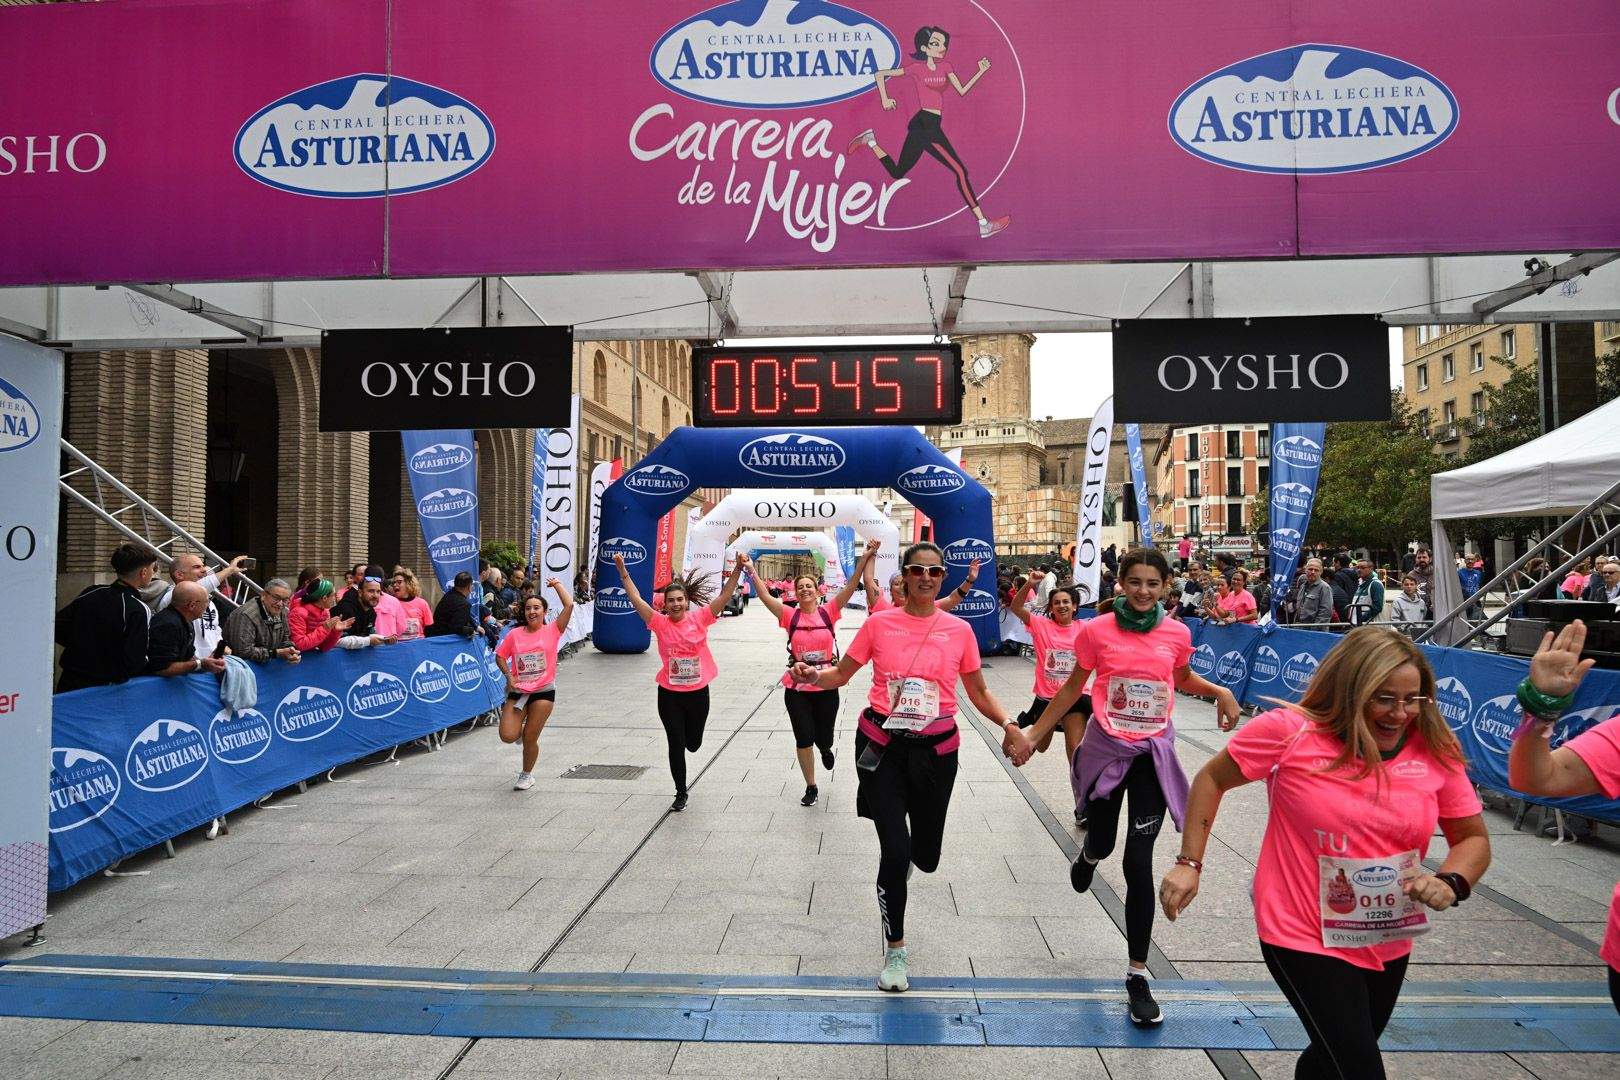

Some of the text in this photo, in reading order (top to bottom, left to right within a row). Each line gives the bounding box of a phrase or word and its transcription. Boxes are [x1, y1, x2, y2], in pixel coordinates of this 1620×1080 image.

[708, 32, 873, 46] CENTRAL LECHERA
[669, 38, 880, 81] ASTURIANA
[1234, 86, 1426, 104] CENTRAL LECHERA
[294, 114, 466, 132] CENTRAL LECHERA
[1191, 96, 1436, 143] ASTURIANA
[628, 103, 832, 162] Carrera
[253, 123, 474, 168] ASTURIANA
[678, 154, 911, 252] de la Mujer
[361, 362, 536, 398] OYSHO
[1158, 352, 1350, 392] OYSHO
[747, 446, 838, 467] ASTURIANA
[627, 475, 685, 489] ASTURIANA
[902, 476, 961, 489] ASTURIANA
[546, 428, 572, 572] OYSHO
[1079, 426, 1107, 568] OYSHO
[754, 502, 836, 519] OYSHO
[945, 550, 992, 560] ASTURIANA
[658, 554, 668, 583] Sports
[596, 599, 636, 608] ASTURIAN
[950, 600, 994, 611] STURIANA
[353, 688, 404, 712] ASTURIANA
[900, 697, 920, 706] 016
[1129, 700, 1149, 708] 016
[280, 705, 340, 734] ASTURIANA
[216, 726, 269, 754] ASTURIANA
[135, 742, 207, 782] ASTURIANA
[1313, 829, 1348, 852] TU
[877, 884, 891, 936] NIKE
[1360, 893, 1395, 907] 016
[1365, 910, 1393, 920] 12296
